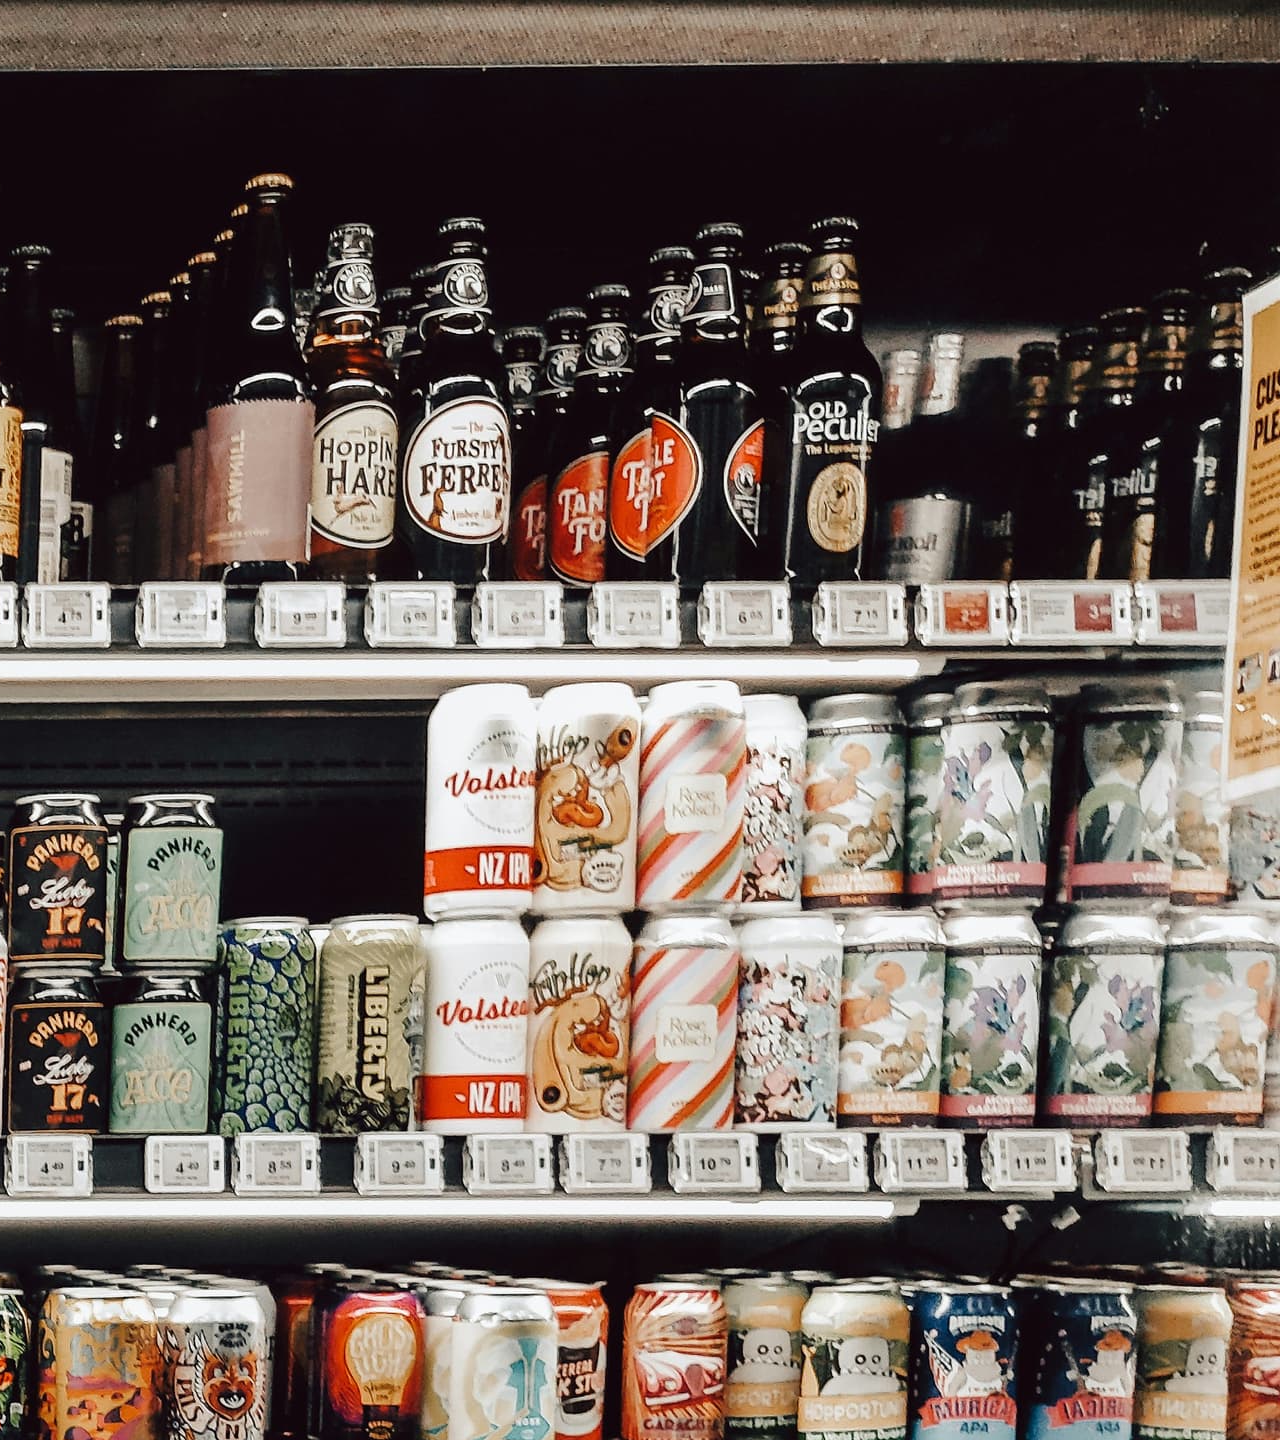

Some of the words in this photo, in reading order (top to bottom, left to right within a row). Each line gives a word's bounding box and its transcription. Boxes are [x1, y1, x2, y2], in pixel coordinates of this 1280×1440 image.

[794, 410, 880, 444] Peculier
[809, 402, 848, 420] OLD
[432, 438, 501, 461] FURSTY
[228, 429, 247, 523] SAWMILL
[327, 466, 397, 498] HARE
[28, 834, 98, 871] PANHEAD
[147, 837, 217, 871] PANHEAD
[480, 855, 503, 886] NZ
[32, 875, 95, 908] Lucky
[46, 909, 85, 934] 17
[357, 966, 389, 1104] LIBERTY
[960, 1422, 990, 1434] APA
